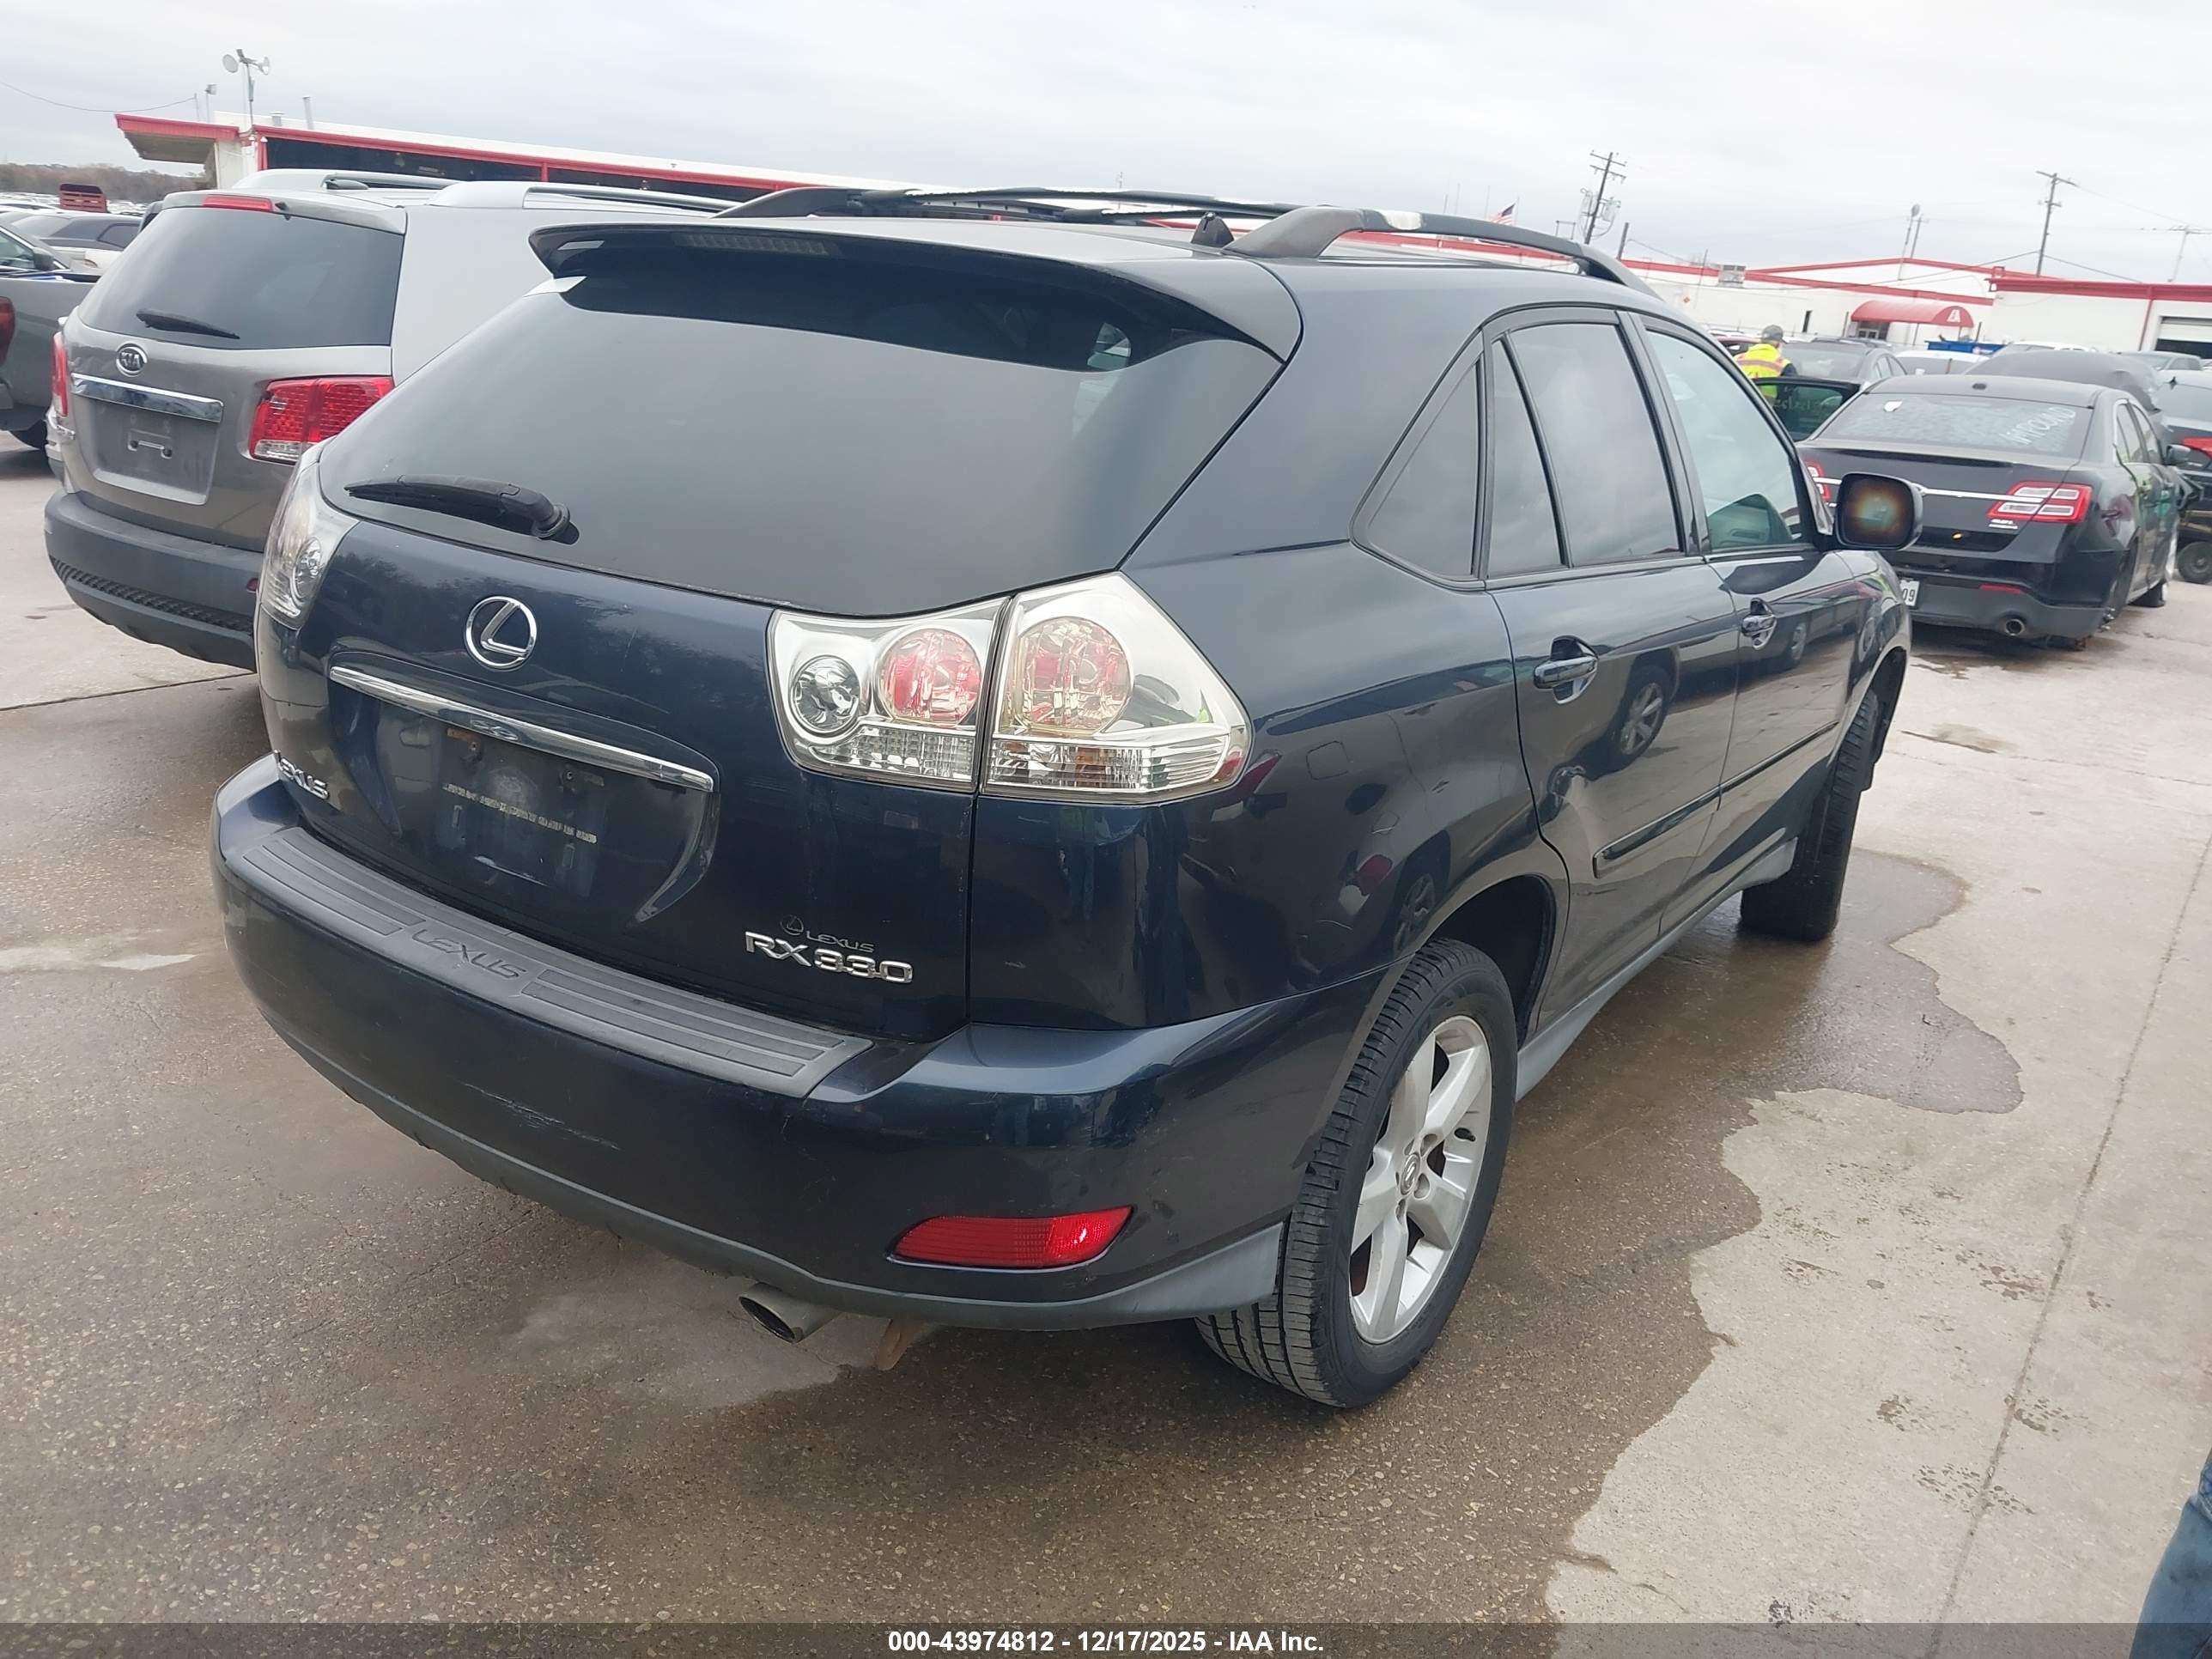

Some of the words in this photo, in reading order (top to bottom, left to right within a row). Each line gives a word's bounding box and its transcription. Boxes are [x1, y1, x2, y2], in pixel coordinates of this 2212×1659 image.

[273, 749, 330, 799] LEXUS
[411, 928, 527, 979] LEXUS
[805, 930, 875, 953] LEXUS
